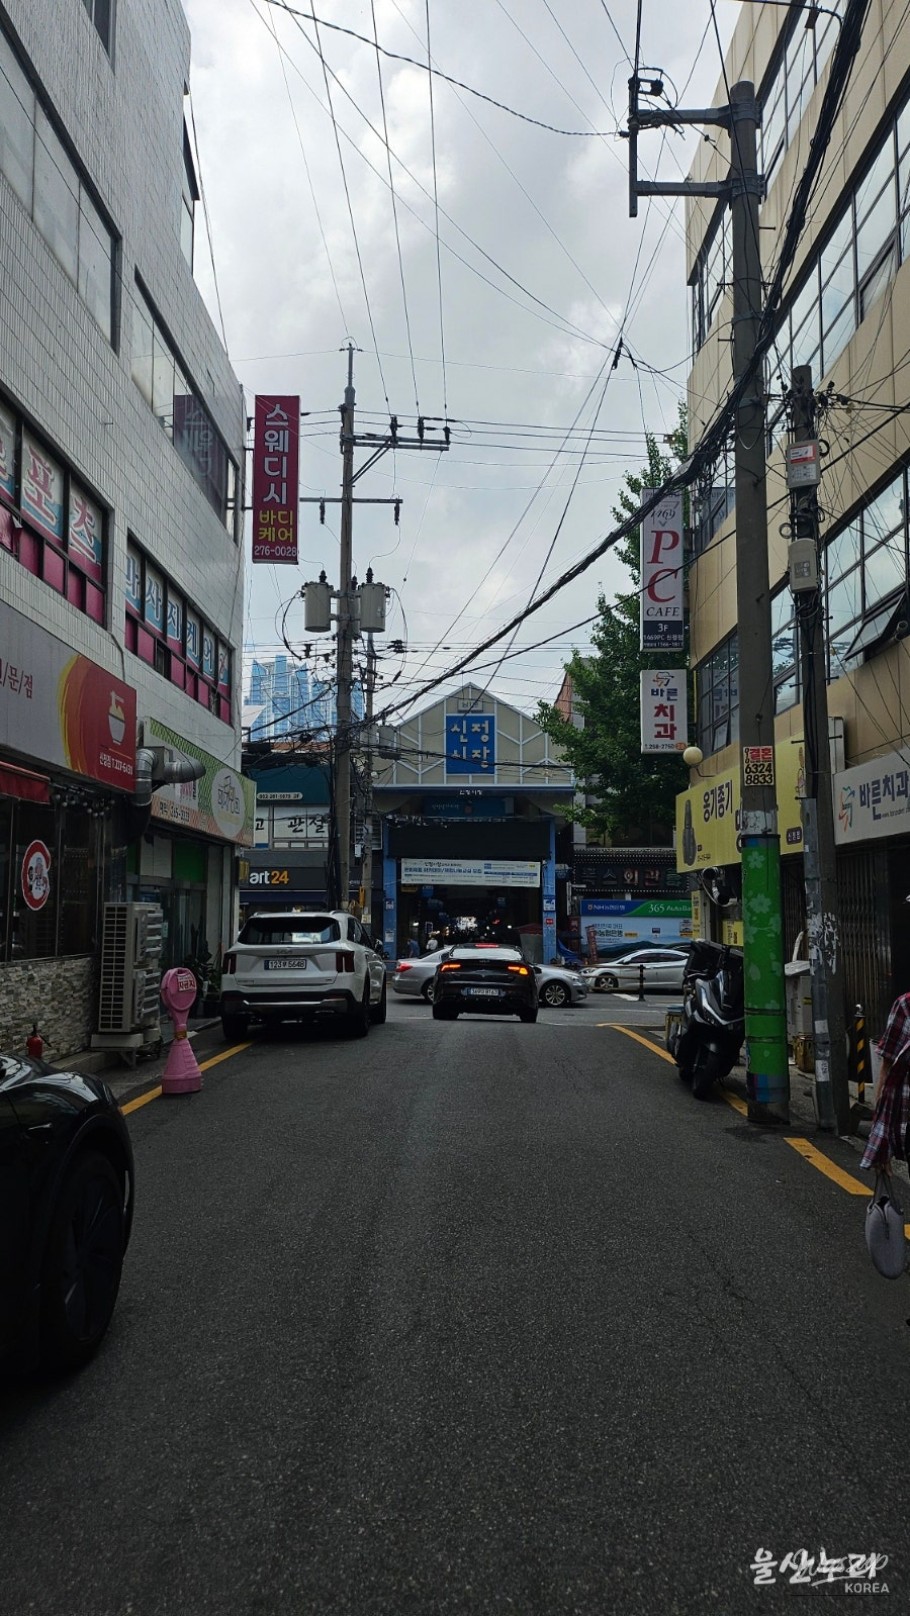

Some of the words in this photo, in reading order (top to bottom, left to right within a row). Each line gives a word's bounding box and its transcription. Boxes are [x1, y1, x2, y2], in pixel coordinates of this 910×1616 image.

[263, 403, 289, 505] 스웨디시
[0, 440, 97, 563] 포츠
[259, 510, 293, 525] 바디
[259, 527, 293, 542] 케어
[254, 545, 298, 557] 276-0028
[646, 606, 681, 617] CAFE
[657, 623, 669, 633] 3F
[651, 688, 678, 701] 바른
[654, 703, 677, 740] 치과
[451, 720, 489, 742] 신정
[451, 746, 490, 768] 시장
[745, 763, 772, 774] 6324
[745, 773, 773, 785] 8833
[703, 779, 733, 823] 옹기종기
[859, 770, 909, 821] 바른치과
[648, 904, 665, 913] 365
